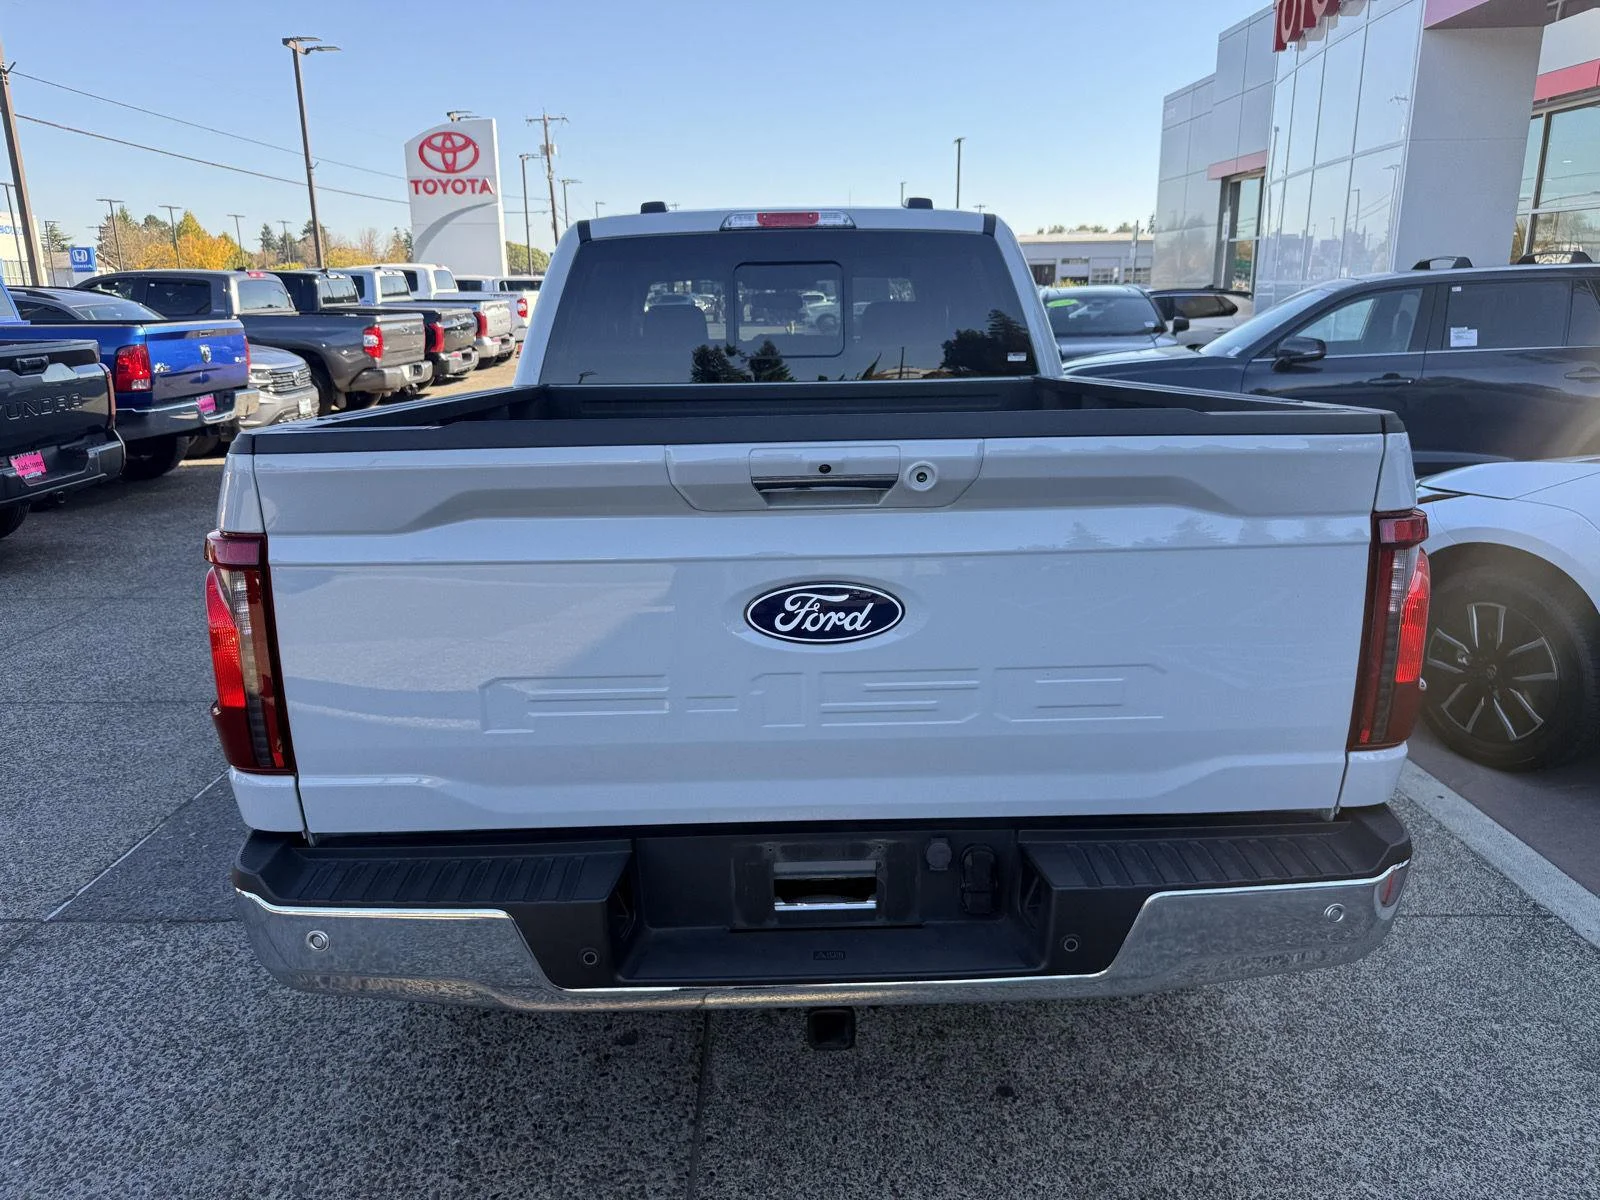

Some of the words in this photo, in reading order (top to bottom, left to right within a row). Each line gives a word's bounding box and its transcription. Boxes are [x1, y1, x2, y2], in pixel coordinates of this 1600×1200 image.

[409, 178, 496, 195] TOYOTA
[0, 392, 83, 421] UNDRA
[774, 592, 874, 632] Ford
[479, 664, 1166, 736] F-150
